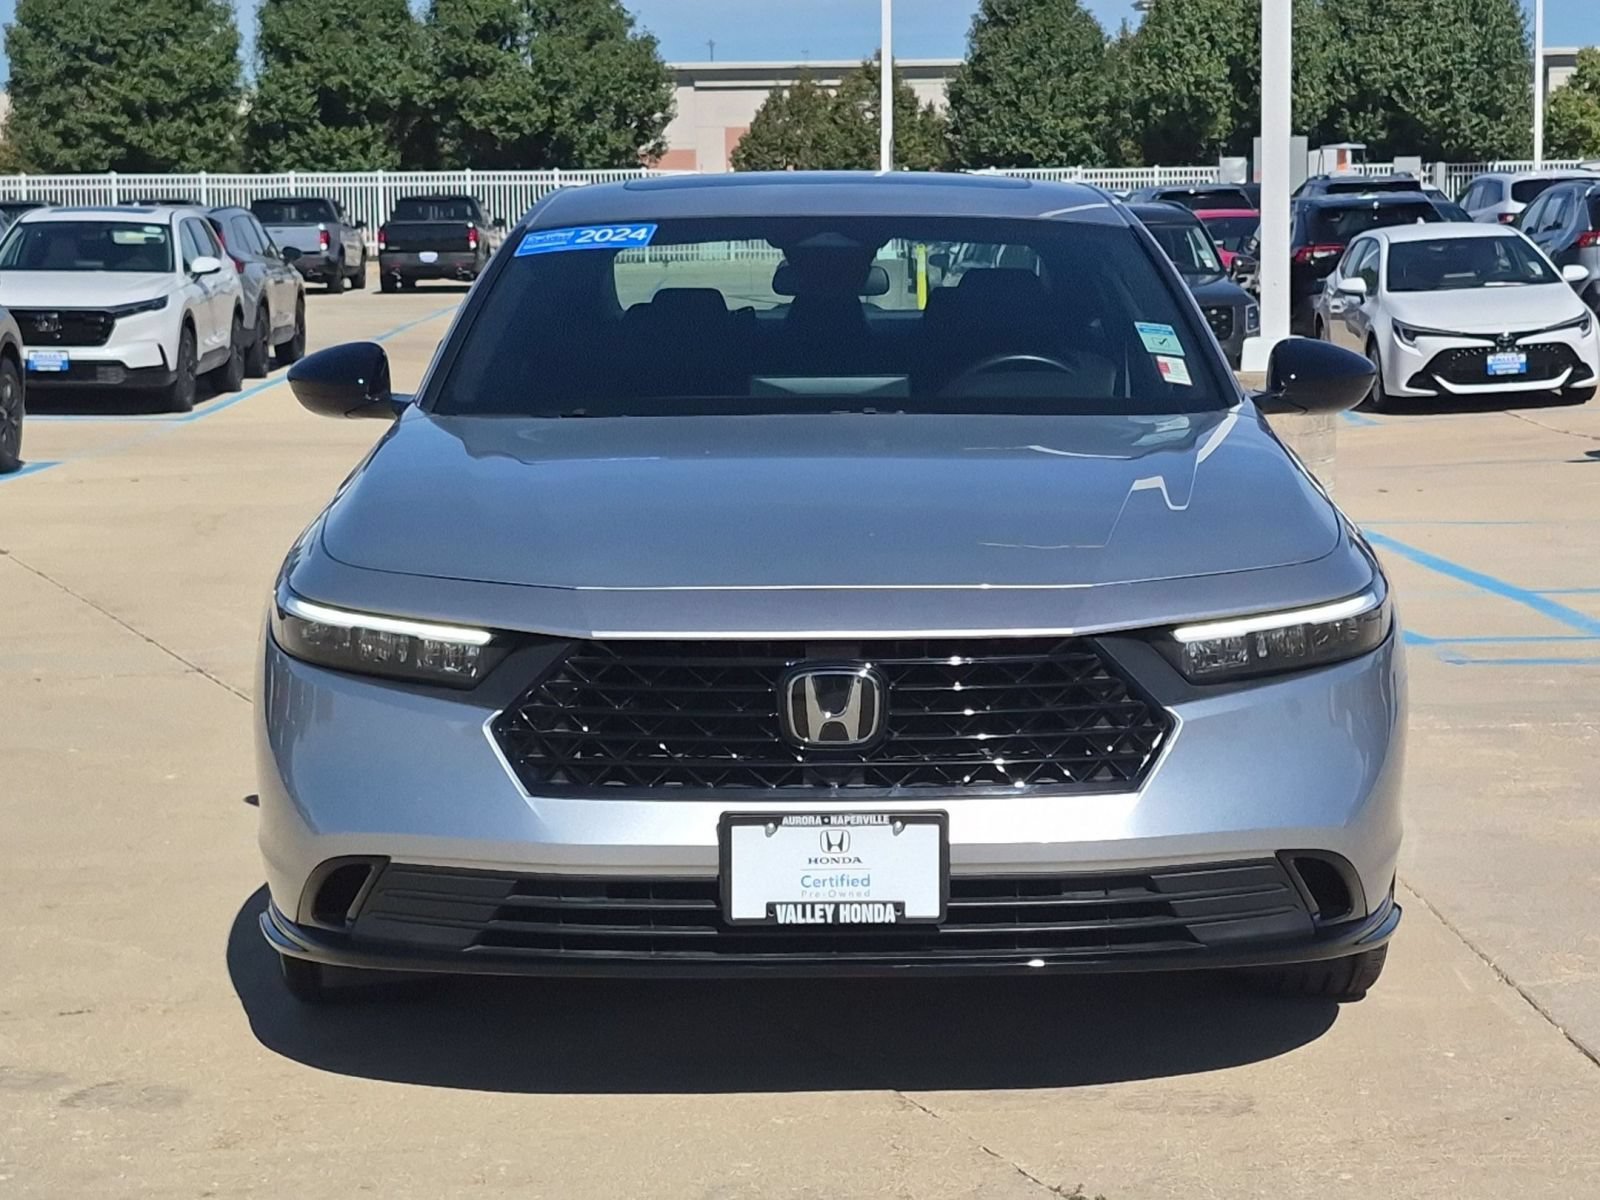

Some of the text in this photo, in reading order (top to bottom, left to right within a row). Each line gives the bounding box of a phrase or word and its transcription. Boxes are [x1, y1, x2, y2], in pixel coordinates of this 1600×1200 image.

[574, 227, 648, 243] 2024
[782, 815, 890, 825] AURORA NAPERVILLE
[801, 874, 871, 888] Certified
[801, 889, 871, 898] Pre-Owned
[775, 904, 896, 924] VALLEY HONDA
